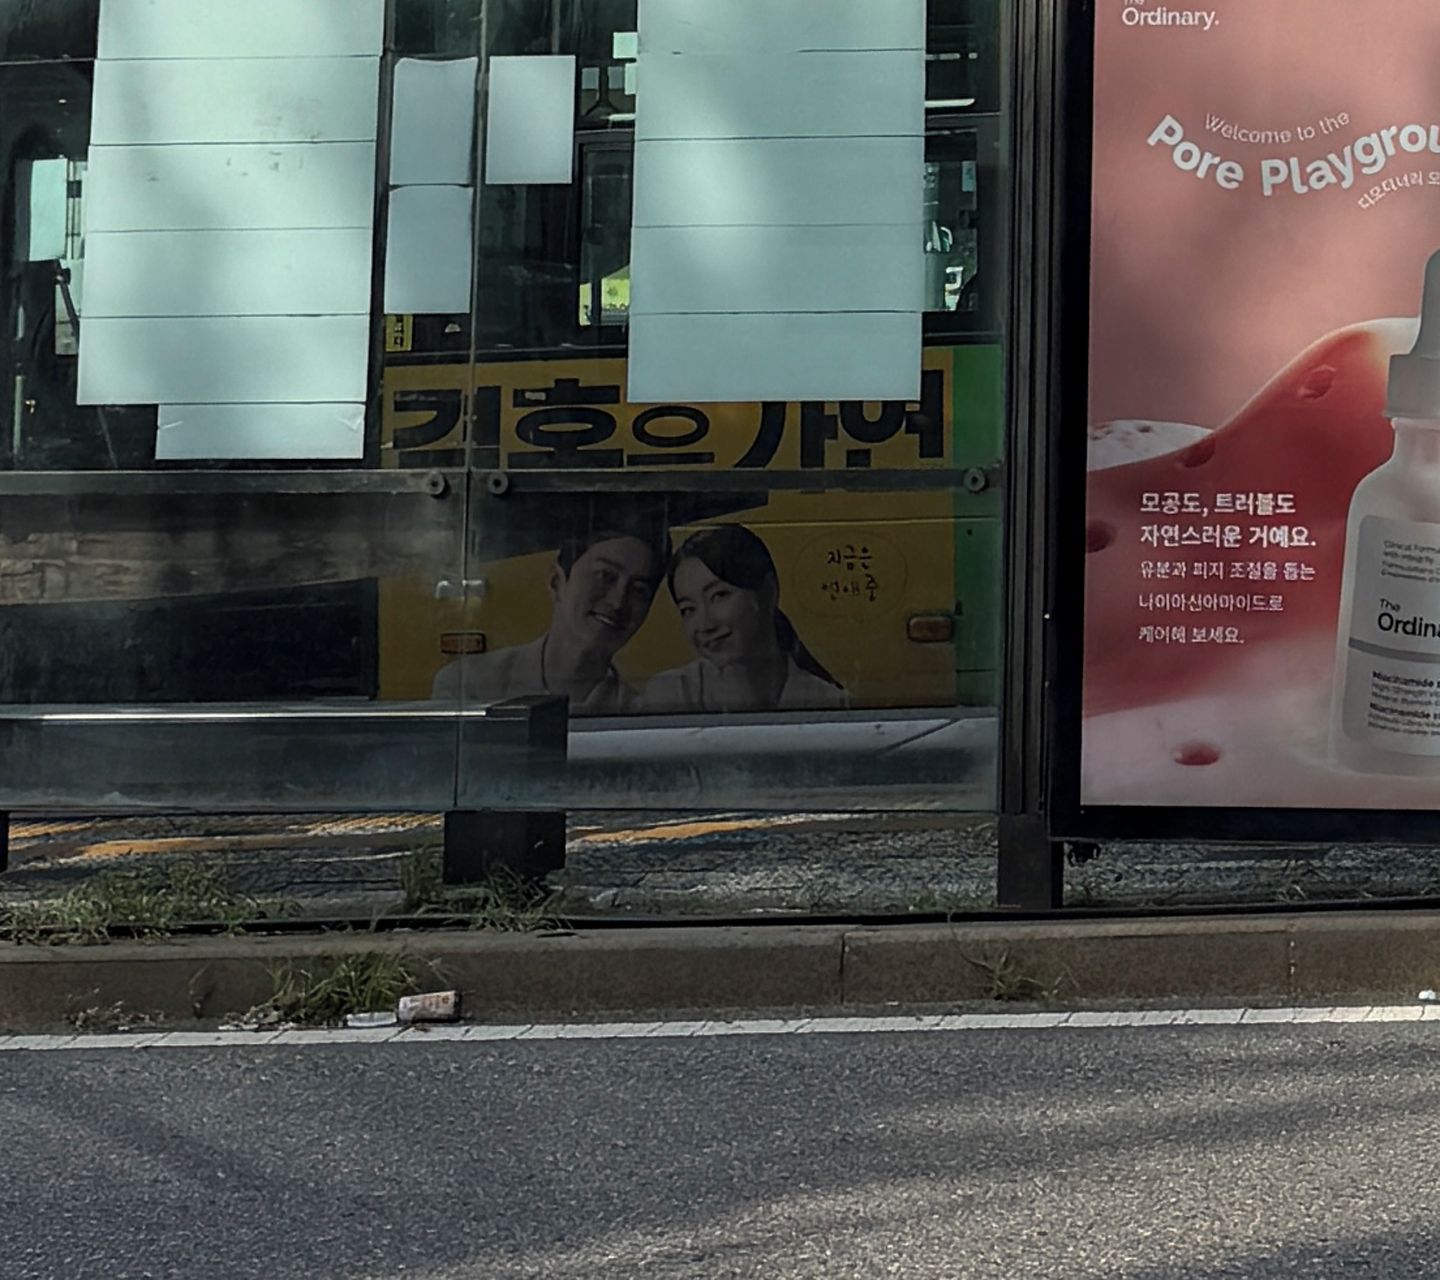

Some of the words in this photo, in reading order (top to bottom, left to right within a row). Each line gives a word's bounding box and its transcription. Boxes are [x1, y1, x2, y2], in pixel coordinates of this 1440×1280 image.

[1121, 6, 1220, 32] Ordinary.
[1204, 111, 1292, 146] Welcome
[1296, 124, 1316, 143] to
[1318, 109, 1352, 137] the
[1146, 114, 1245, 192] Pore
[392, 378, 715, 470] 결혼은
[1140, 492, 1209, 518] 모공도,
[1213, 492, 1297, 517] 트러블도
[1140, 525, 1242, 549] 자연스러운
[1248, 525, 1318, 549] 거예요.
[827, 544, 873, 571] 지금은
[1140, 560, 1187, 580] 유분과
[1192, 561, 1225, 580] 피지
[1229, 561, 1278, 581] 조절을
[864, 572, 878, 603] 중
[1138, 592, 1284, 612] 나이아신아마이드로
[1378, 598, 1402, 613] The
[1191, 625, 1245, 645] 보세요.
